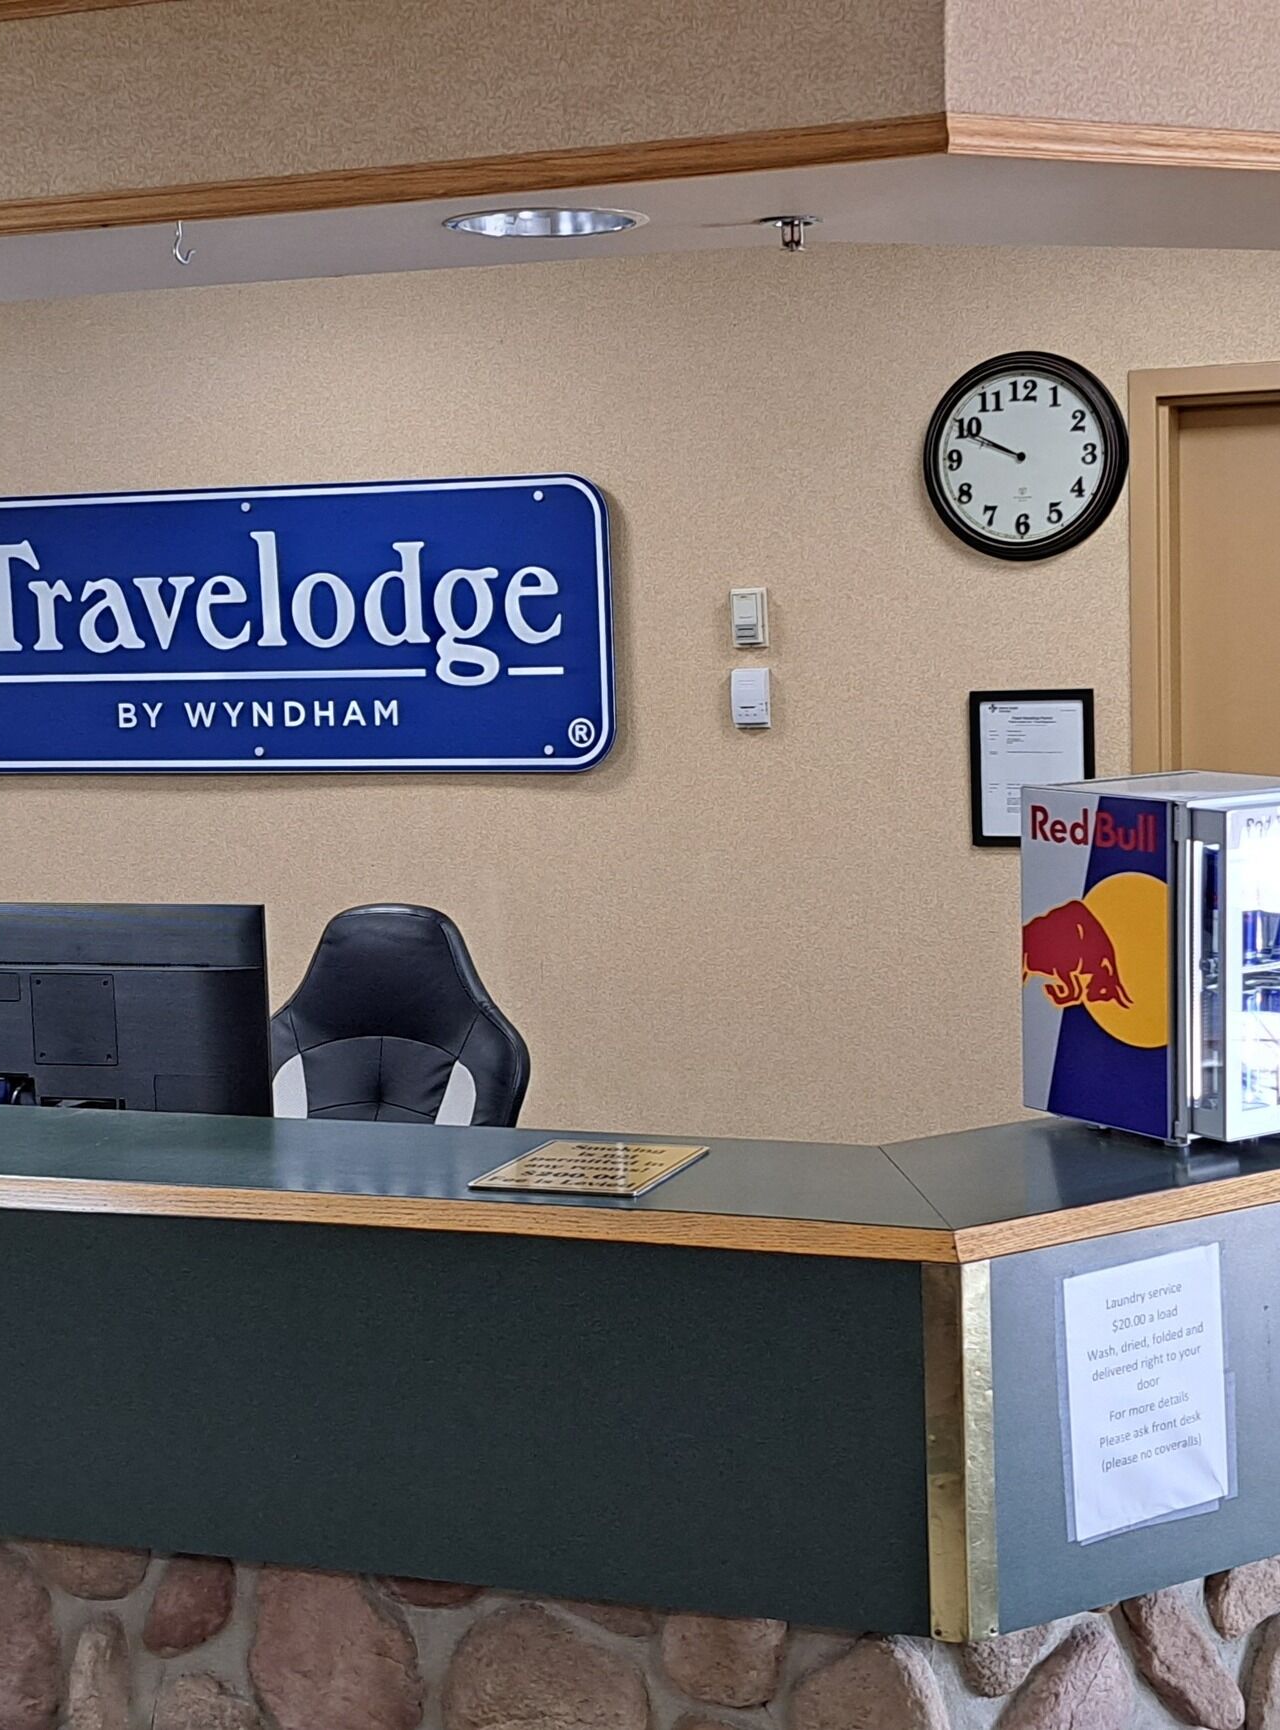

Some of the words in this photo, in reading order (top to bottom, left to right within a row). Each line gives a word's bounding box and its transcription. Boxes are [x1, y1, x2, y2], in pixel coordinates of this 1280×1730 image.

[978, 390, 1004, 413] 11
[1009, 379, 1038, 402] 12
[1049, 385, 1062, 408] 1
[955, 416, 982, 440] 10
[1070, 409, 1087, 433] 2
[947, 449, 963, 471] 9
[1081, 442, 1098, 465] 3
[957, 482, 973, 505] 8
[1070, 476, 1085, 498] 4
[983, 504, 998, 527] 7
[1047, 501, 1063, 524] 5
[1015, 513, 1030, 536] 6
[117, 702, 163, 729] BY
[184, 699, 400, 728] WYNDHAM
[1030, 805, 1089, 846] Red
[1094, 810, 1159, 853] Bull
[1105, 1291, 1147, 1311] Laundry
[1148, 1283, 1183, 1300] service
[1111, 1313, 1147, 1334] $20.00
[1149, 1313, 1155, 1323] a
[1157, 1305, 1179, 1321] load
[1087, 1345, 1119, 1362] Wash,
[1121, 1336, 1150, 1353] dried,
[1152, 1327, 1184, 1345] folded
[1185, 1320, 1204, 1337] and
[1091, 1359, 1139, 1382] delivered
[1141, 1354, 1164, 1370] right
[1166, 1351, 1177, 1361] to
[1178, 1345, 1202, 1361] your
[1136, 1376, 1160, 1391] door
[1109, 1409, 1127, 1422] For
[1128, 1402, 1156, 1417] more
[1157, 1391, 1190, 1409] details
[1099, 1431, 1132, 1449] Please
[1133, 1424, 1150, 1439] ask
[1152, 1418, 1178, 1434] front
[1179, 1410, 1202, 1426] desk
[1101, 1453, 1139, 1473] (please
[1140, 1449, 1153, 1461] no
[1154, 1432, 1202, 1456] coveralls)
